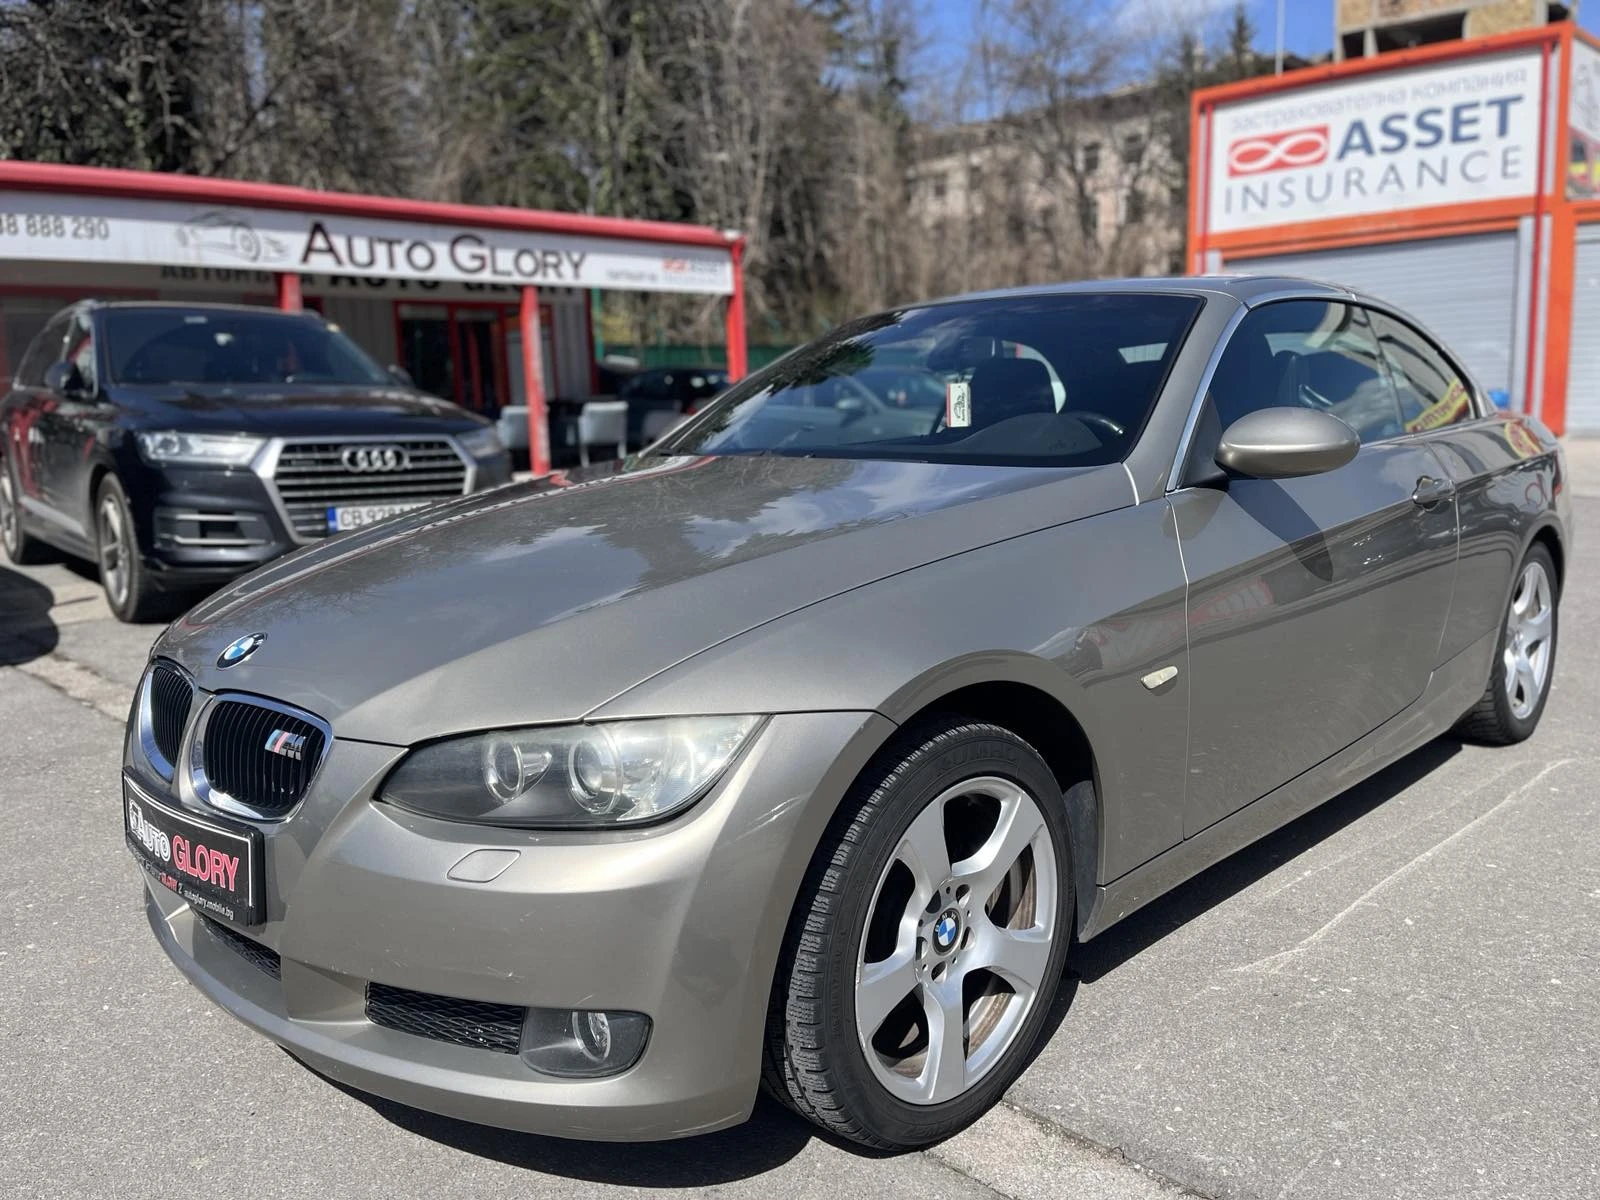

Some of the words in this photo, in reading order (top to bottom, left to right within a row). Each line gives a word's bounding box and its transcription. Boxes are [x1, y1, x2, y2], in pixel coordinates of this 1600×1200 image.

[1337, 94, 1524, 161] ASSET
[1223, 145, 1523, 214] INSURANCE
[301, 220, 437, 271] AUTO
[449, 233, 588, 280] GLORY
[172, 834, 239, 892] GLORY
